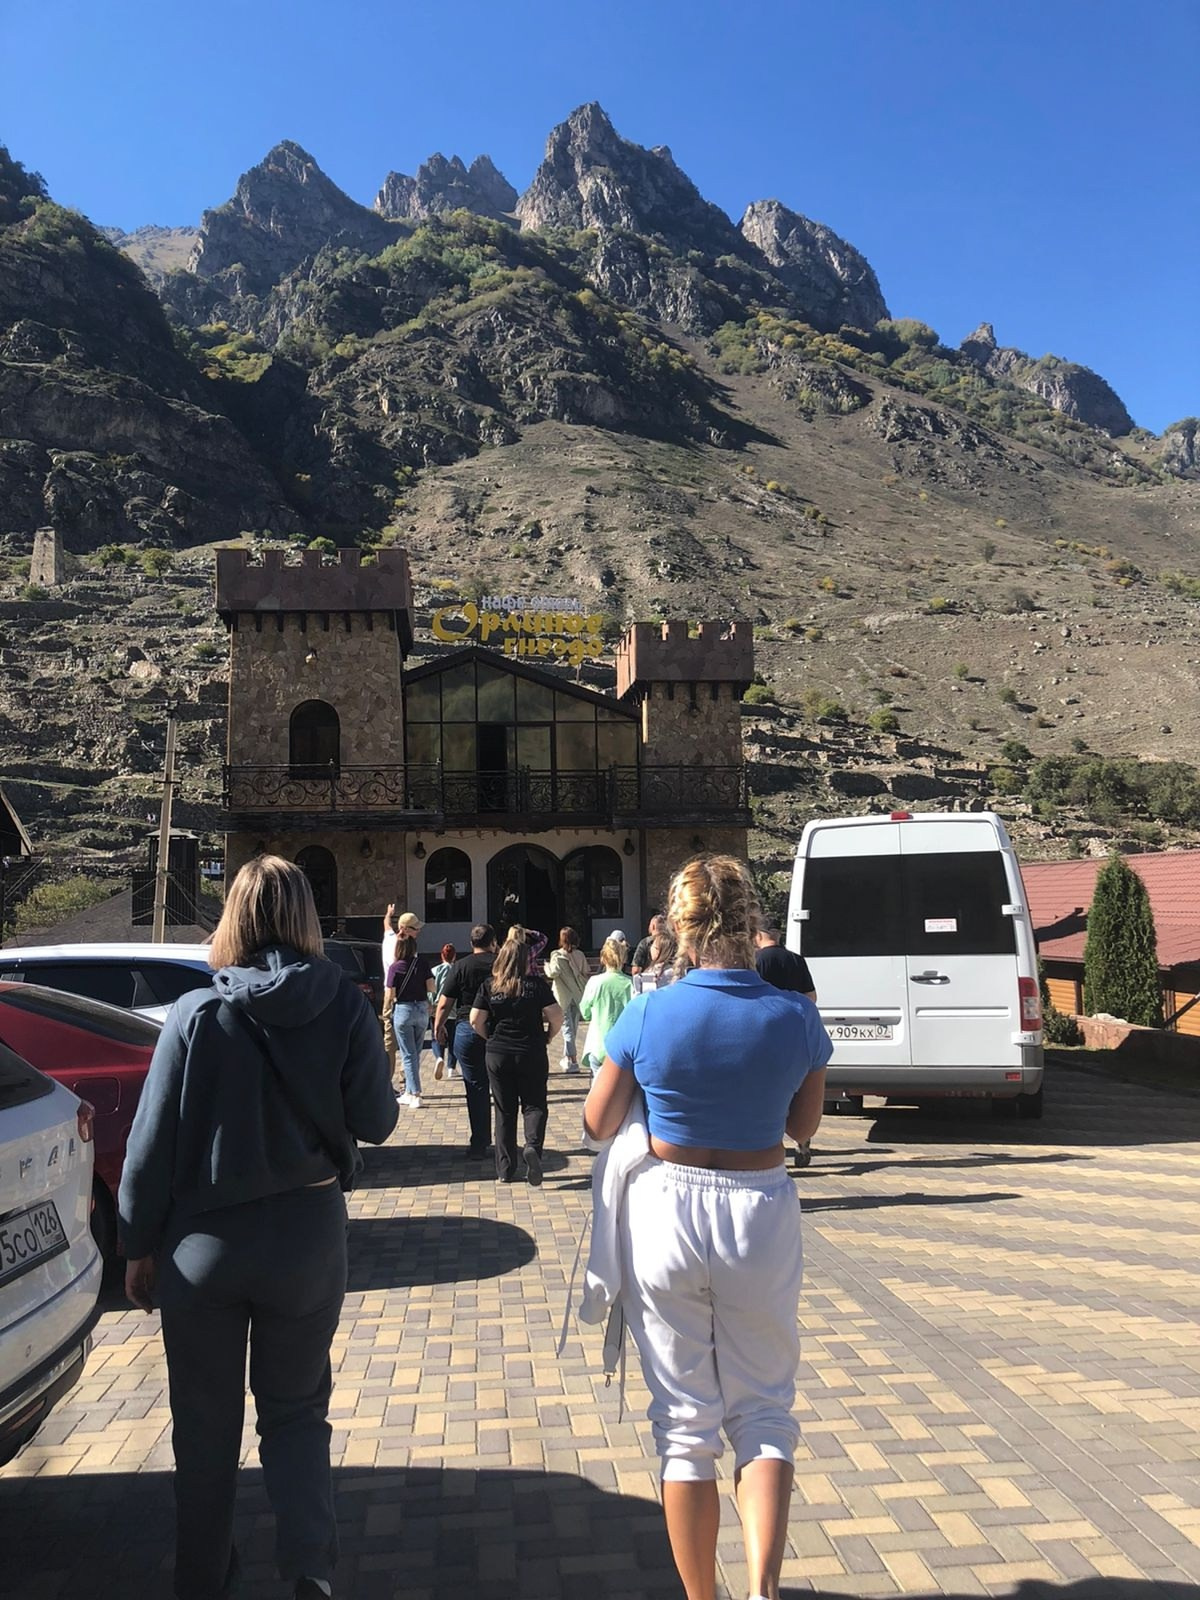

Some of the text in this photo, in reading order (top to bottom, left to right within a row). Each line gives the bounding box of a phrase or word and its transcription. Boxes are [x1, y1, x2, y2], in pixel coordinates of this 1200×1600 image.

[432, 602, 603, 642] Орлиное
[504, 637, 603, 666] гнездо
[34, 1207, 57, 1237] 126
